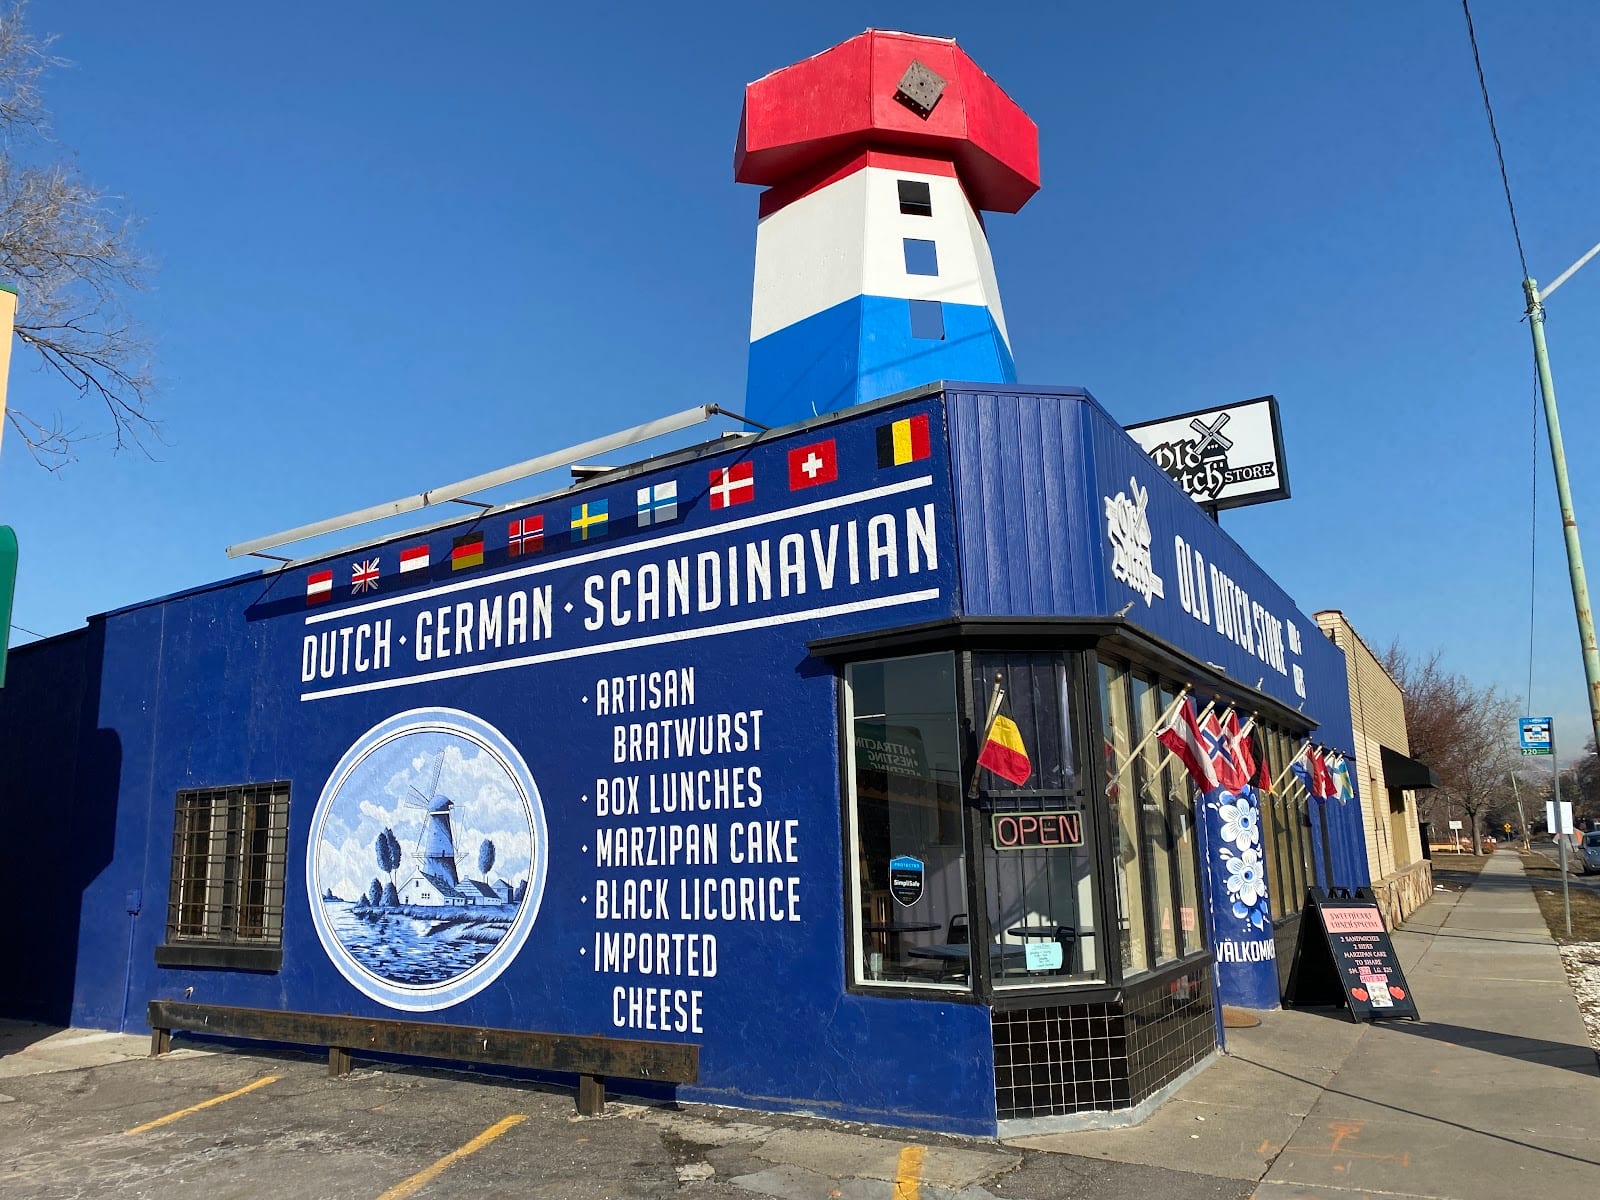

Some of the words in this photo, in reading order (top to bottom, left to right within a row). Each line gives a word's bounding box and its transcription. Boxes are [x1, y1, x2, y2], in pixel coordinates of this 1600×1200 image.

[1151, 443, 1201, 472] Old
[1224, 464, 1272, 484] STORE
[301, 619, 392, 683] DUTCH
[415, 584, 554, 662] GERMAN
[583, 502, 939, 632] SCANDINAVIAN
[1174, 535, 1210, 625] OLD
[1209, 563, 1255, 656] DUTCH
[1252, 601, 1288, 676] STORE
[596, 667, 695, 716] ARTISAN
[613, 710, 764, 763] BRATWURST
[596, 776, 640, 817] BOX
[650, 766, 762, 814] LUNCHES
[596, 823, 718, 868] MARZIPAN
[729, 820, 799, 864] CAKE
[998, 815, 1079, 845] OPEN
[595, 879, 670, 921] BLACK
[680, 877, 801, 922] LICORICE
[893, 879, 921, 887] SimpliSafe
[594, 931, 718, 978] IMPORTED
[612, 986, 704, 1034] CHEESE
